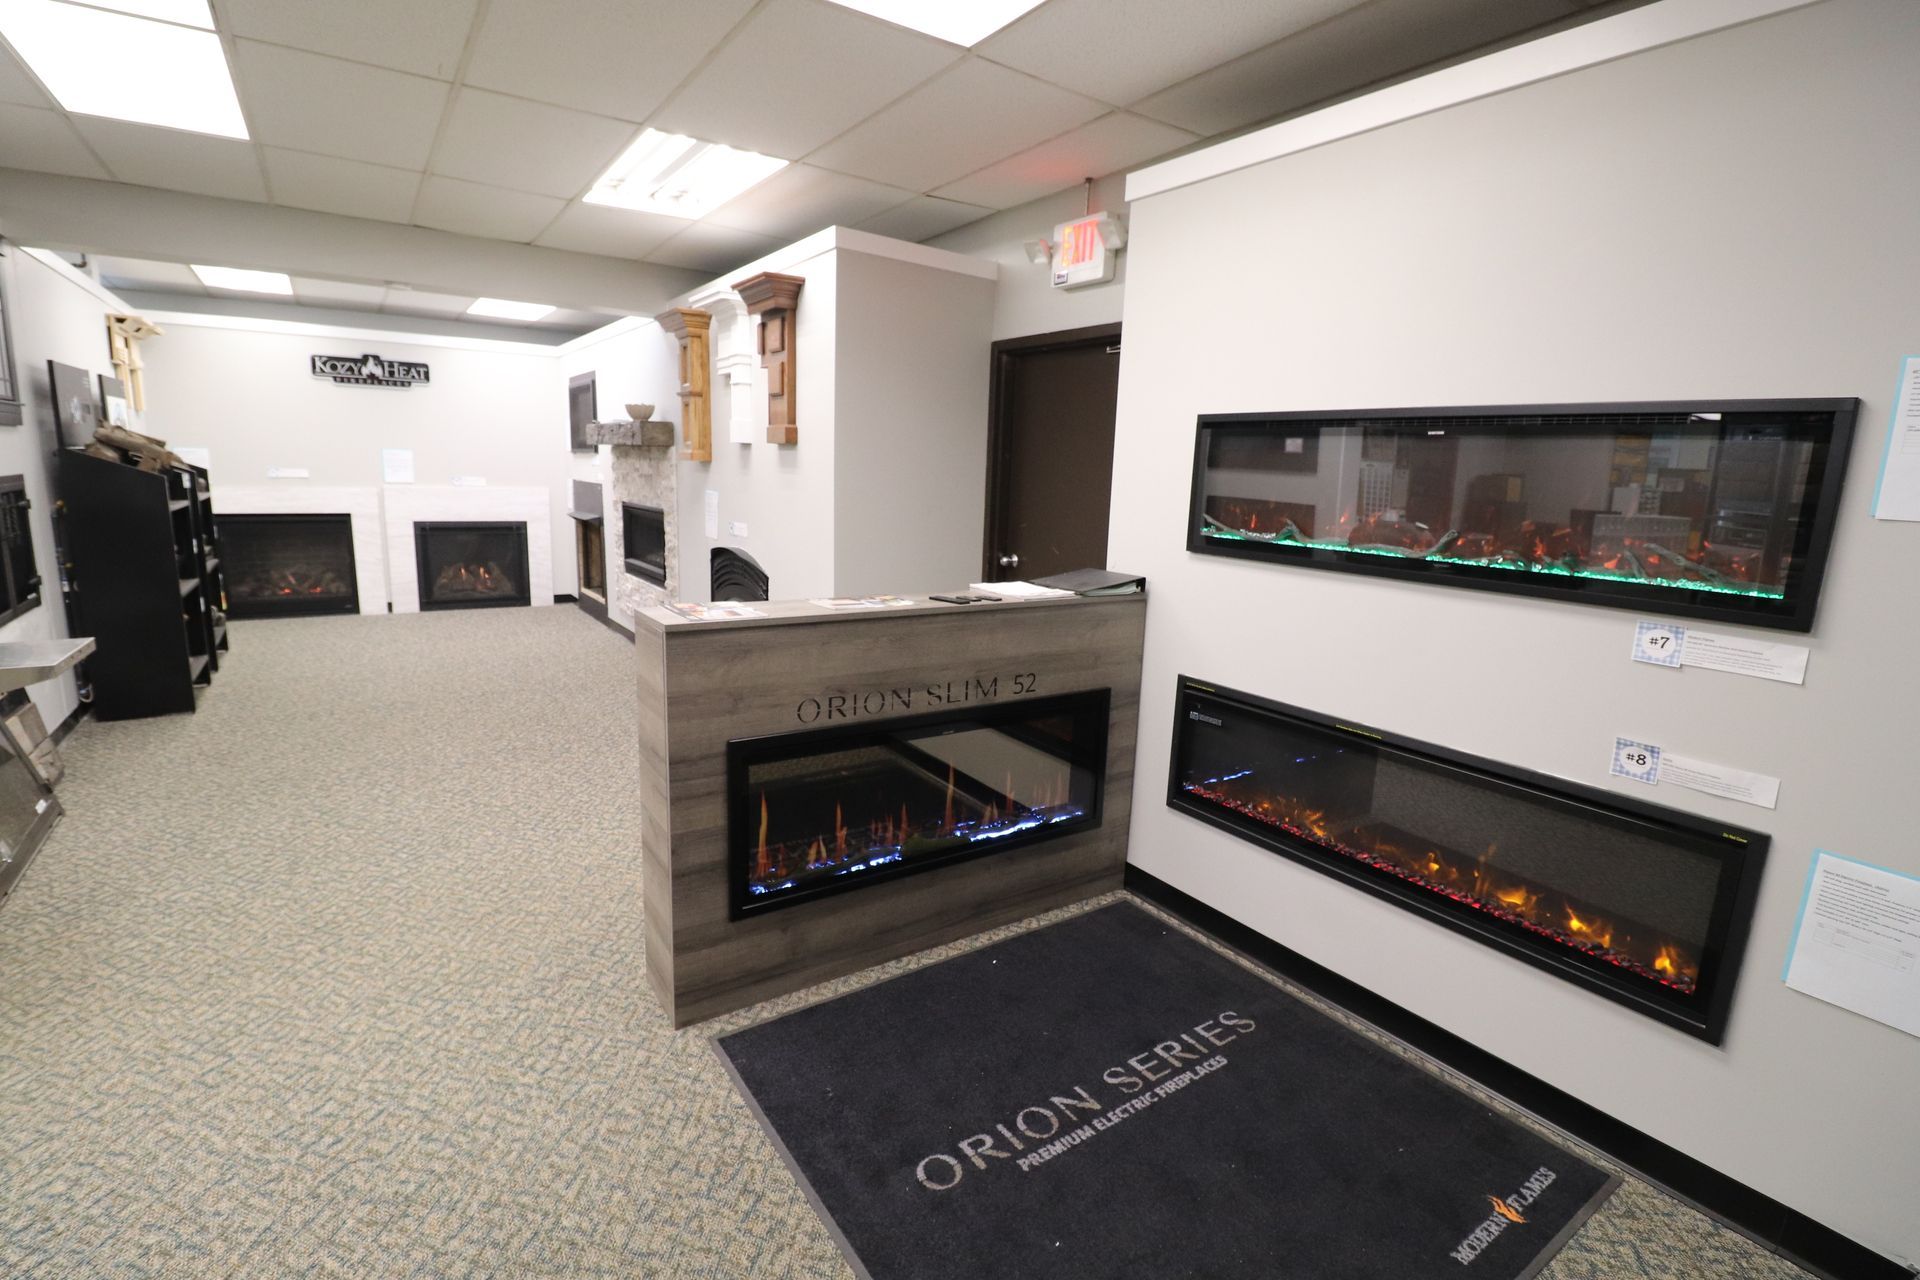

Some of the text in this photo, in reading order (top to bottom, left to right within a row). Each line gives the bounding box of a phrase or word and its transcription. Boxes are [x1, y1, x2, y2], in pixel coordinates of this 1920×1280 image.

[1061, 219, 1099, 267] EXIT
[314, 356, 428, 379] KOZY HEAT
[1649, 636, 1670, 649] #7
[796, 672, 1037, 724] ORION SLIM 52
[1625, 753, 1647, 766] #8
[916, 1011, 1256, 1190] ORION SERIES
[1016, 1055, 1228, 1171] PREMIUM ELECTRIC FIREPLACES
[1450, 1166, 1557, 1265] MODERN FLAMES
